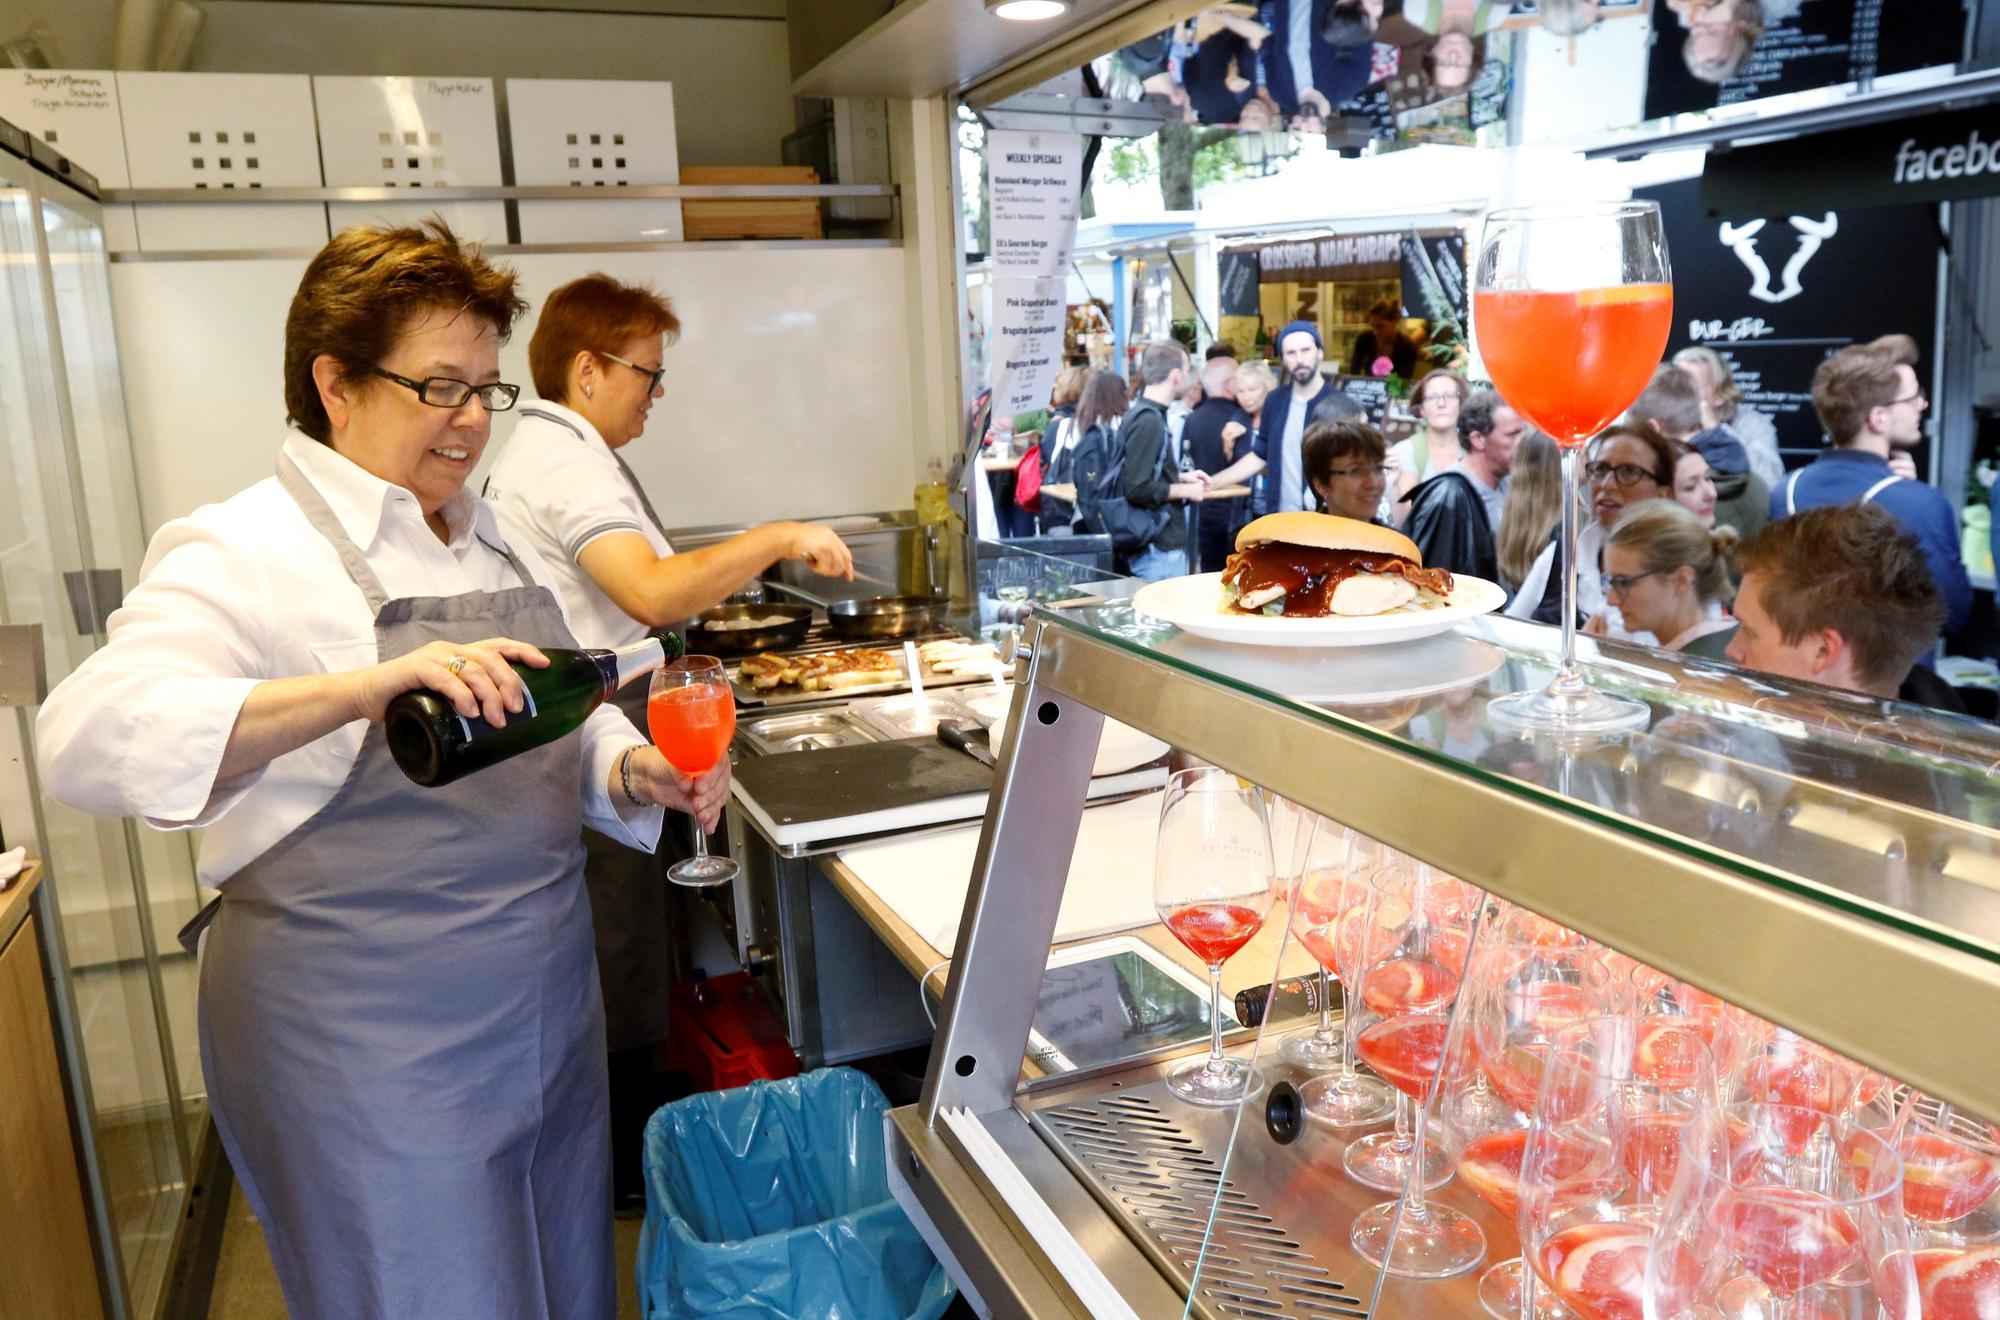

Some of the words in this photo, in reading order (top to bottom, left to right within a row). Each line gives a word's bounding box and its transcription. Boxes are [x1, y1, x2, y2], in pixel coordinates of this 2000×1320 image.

[1006, 153, 1031, 163] WEEKLY
[1032, 154, 1062, 164] SPECIALS
[1031, 239, 1048, 249] Burger
[1006, 298, 1020, 307] Pink
[1689, 317, 1775, 342] BURGER
